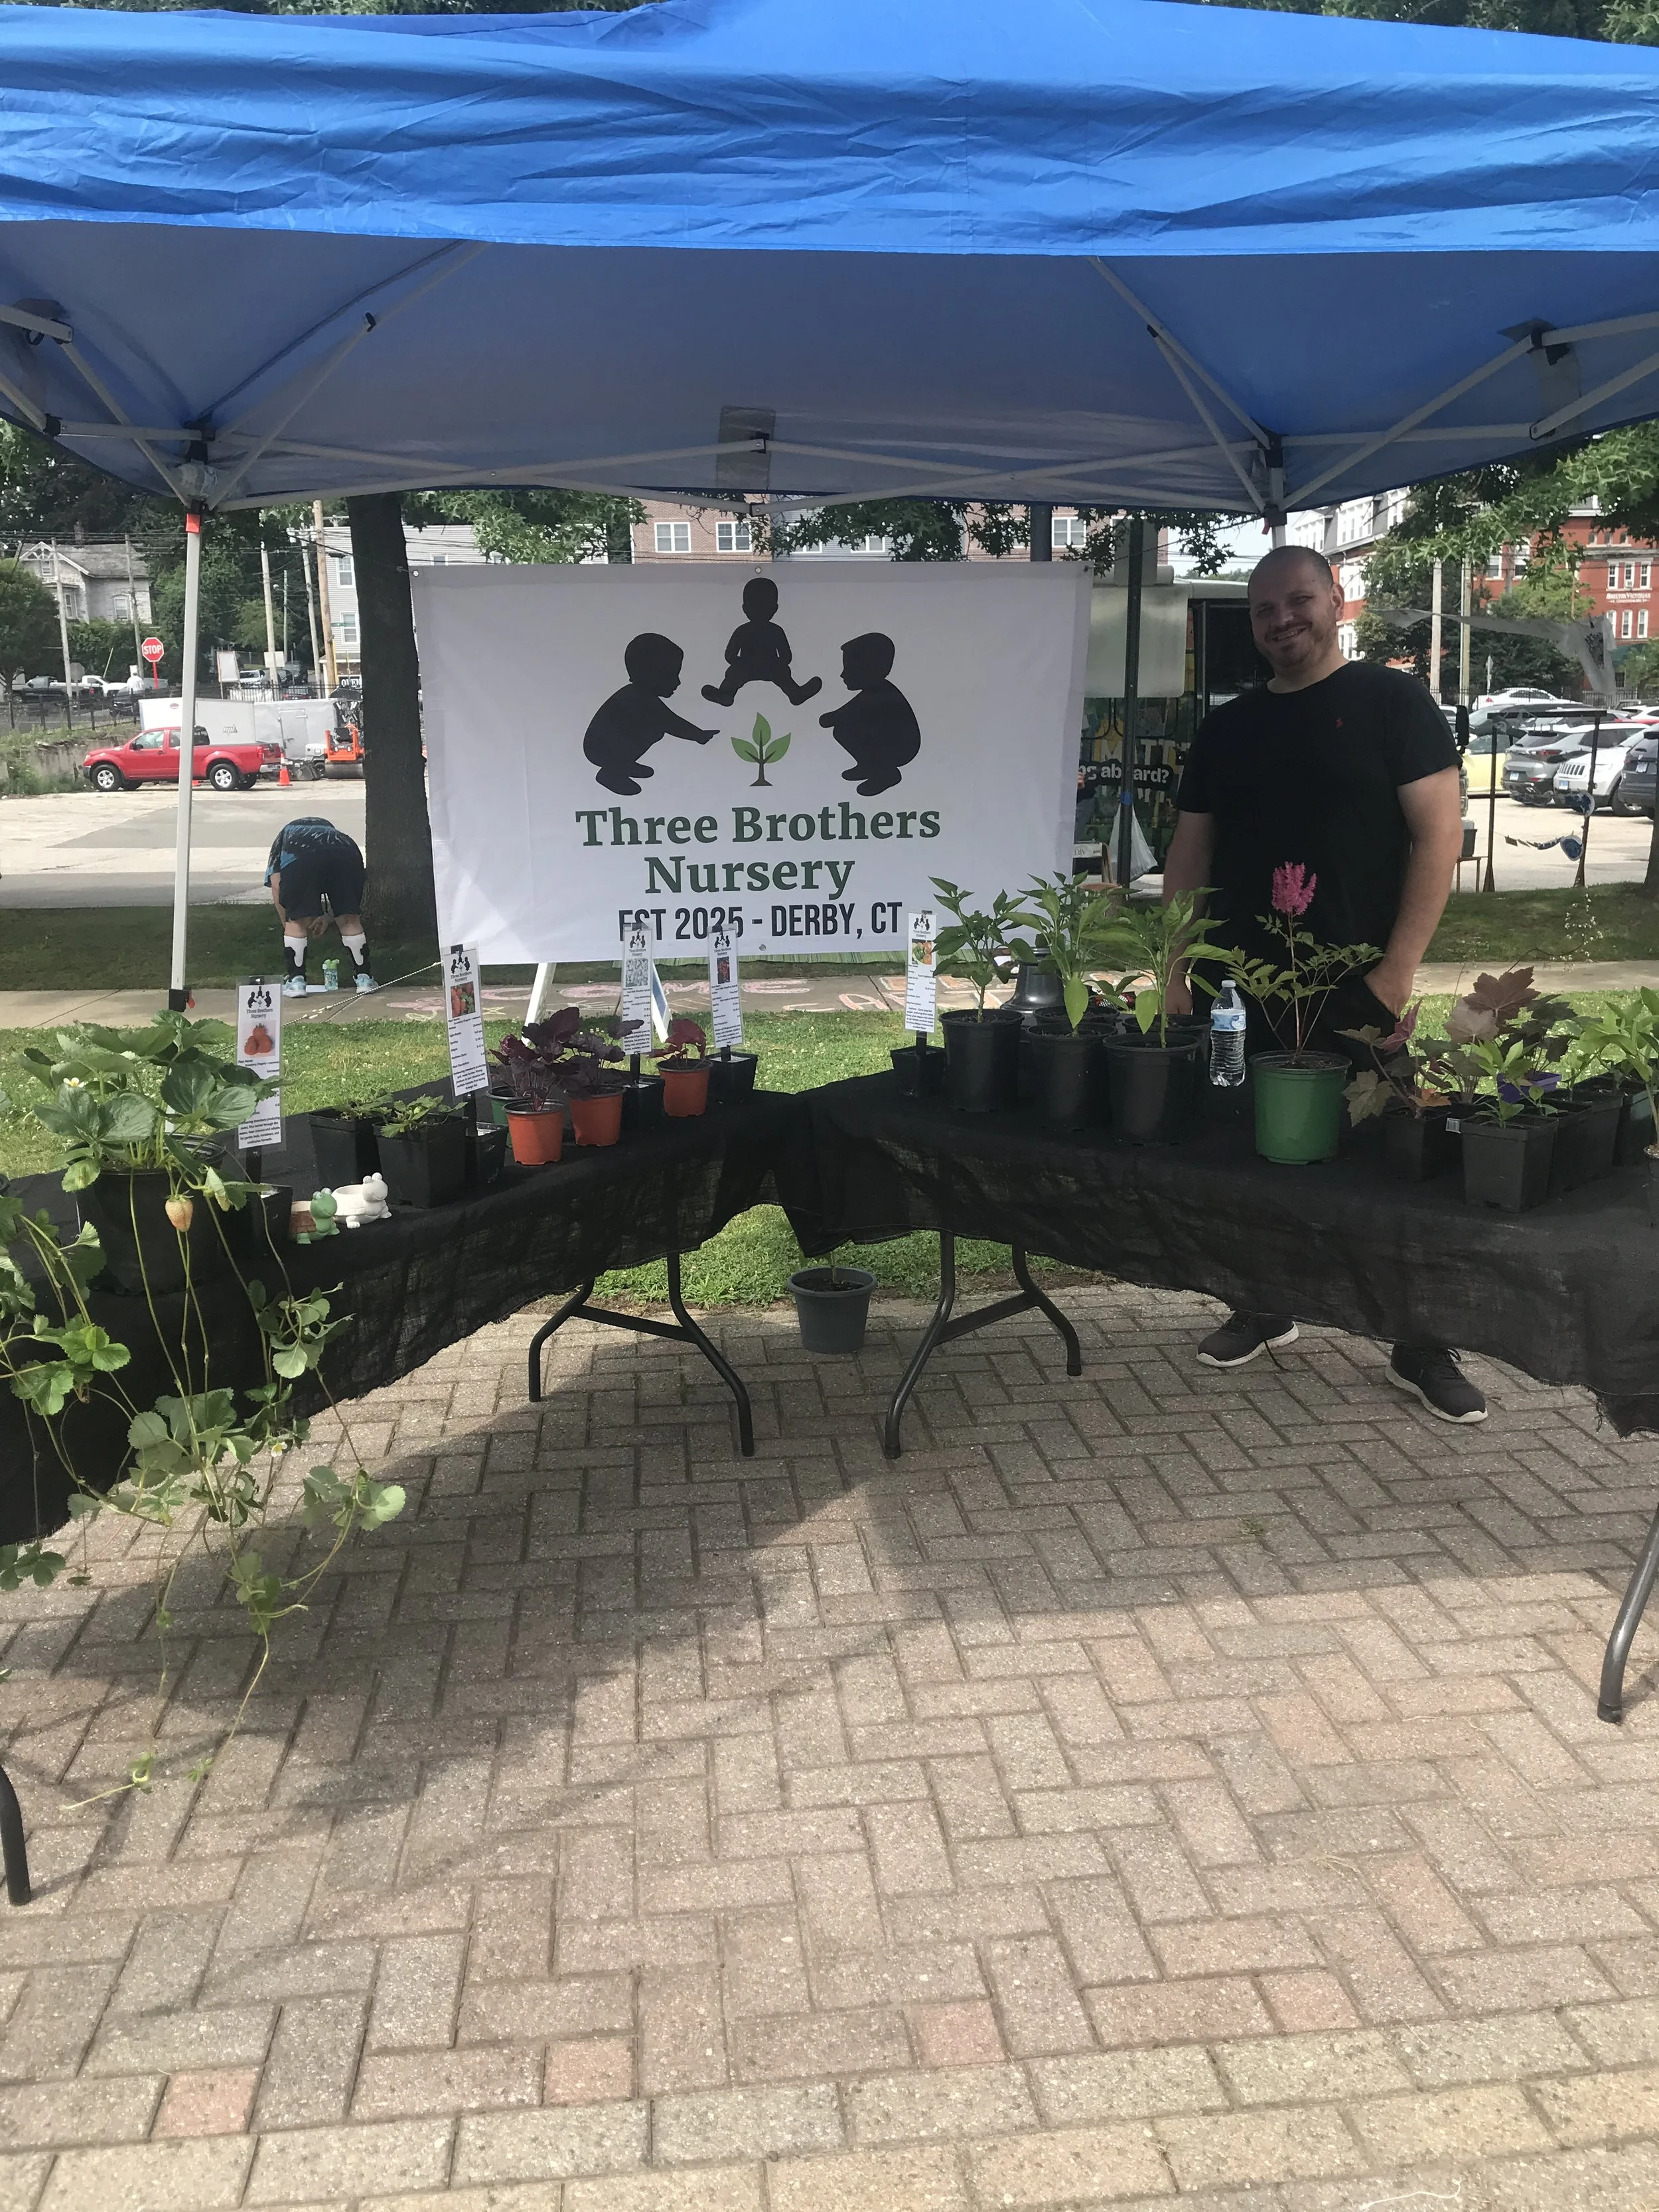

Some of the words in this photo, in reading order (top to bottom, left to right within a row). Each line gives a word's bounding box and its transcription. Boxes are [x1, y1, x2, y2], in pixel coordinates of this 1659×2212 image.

[143, 644, 162, 655] STOP
[1101, 763, 1170, 784] abard?
[575, 806, 718, 846] Three
[732, 801, 940, 843] Brothers
[644, 855, 855, 901] Nursery
[618, 908, 666, 942] EST
[675, 906, 744, 940] 2025
[771, 903, 863, 939] DERBY,
[871, 901, 902, 934] CT
